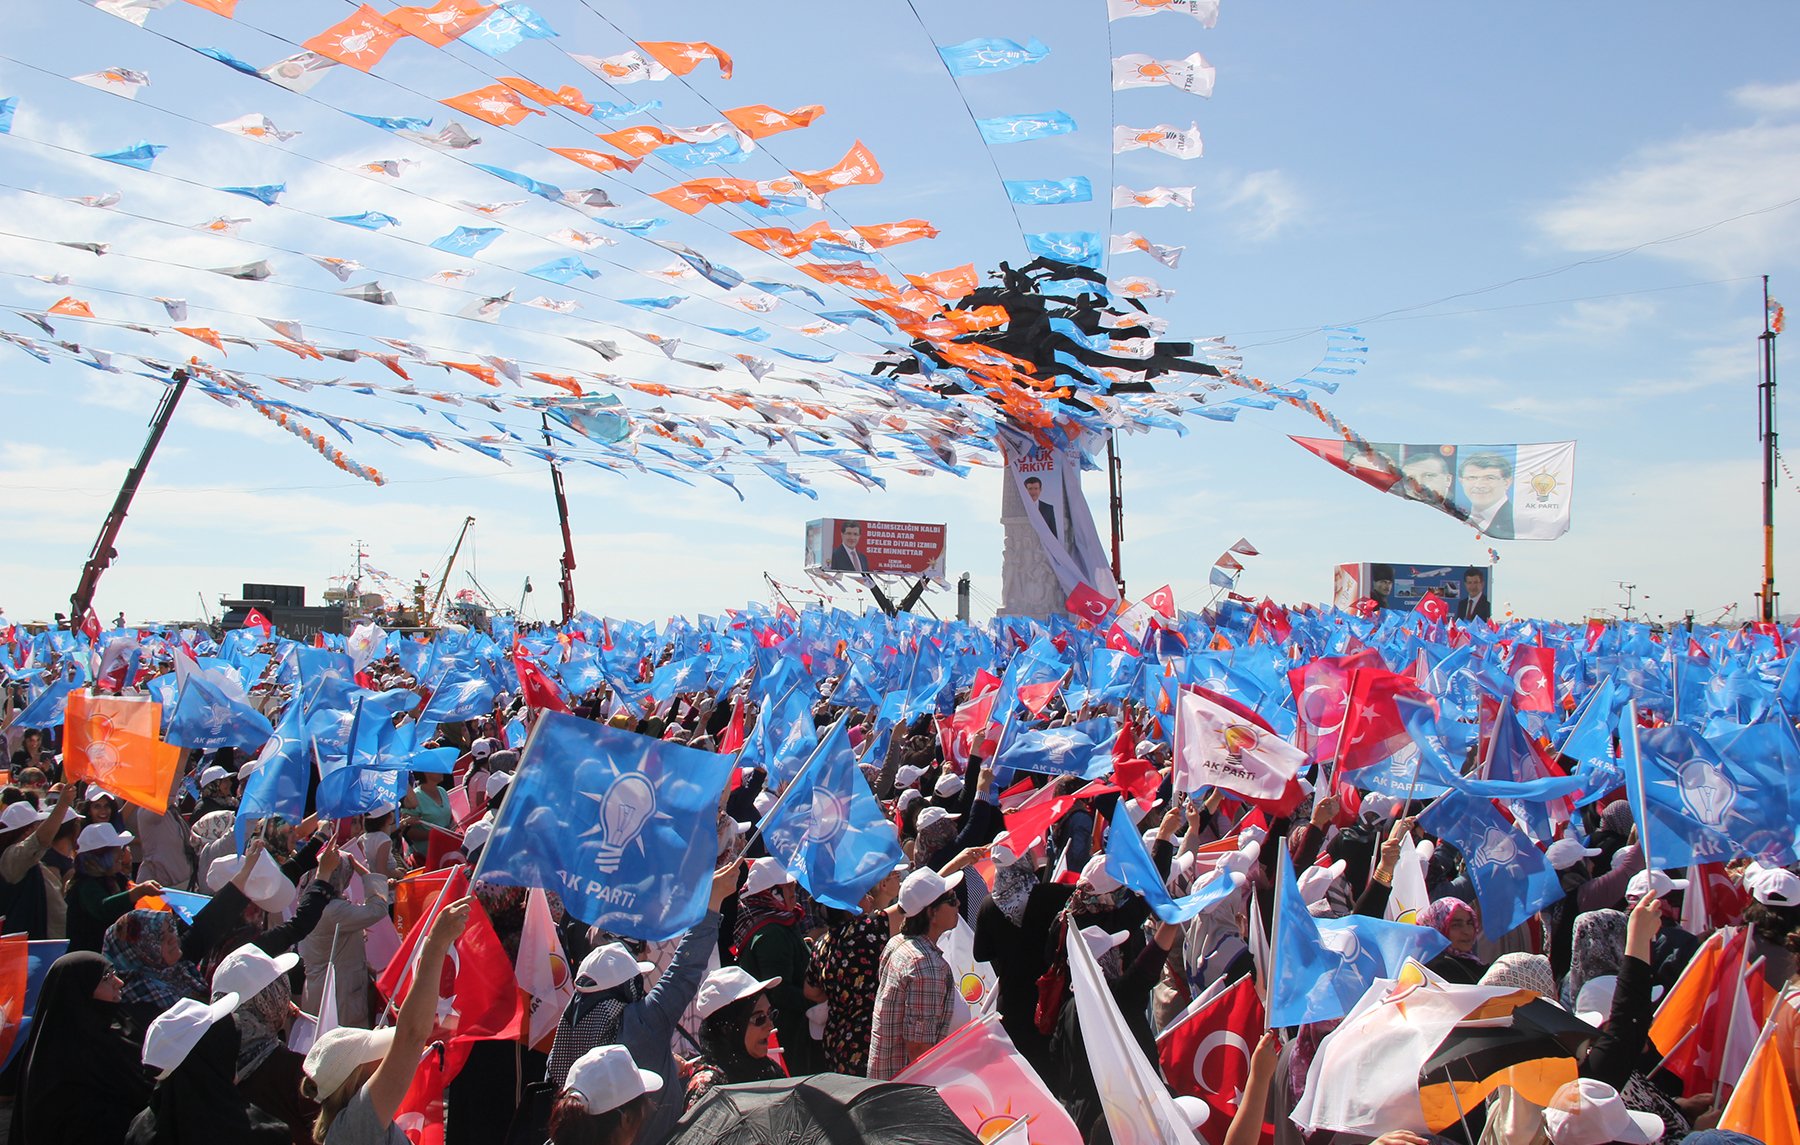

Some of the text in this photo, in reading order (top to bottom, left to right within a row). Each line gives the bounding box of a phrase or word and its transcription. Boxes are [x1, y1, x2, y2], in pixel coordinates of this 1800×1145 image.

[867, 531, 895, 539] BURADA
[1031, 763, 1048, 772] AK
[1202, 760, 1220, 770] AK
[1373, 776, 1388, 787] AK
[771, 831, 790, 855] AK
[1692, 835, 1724, 857] AK
[555, 869, 583, 892] AK
[178, 905, 194, 918] AK
[397, 915, 403, 929] AK
